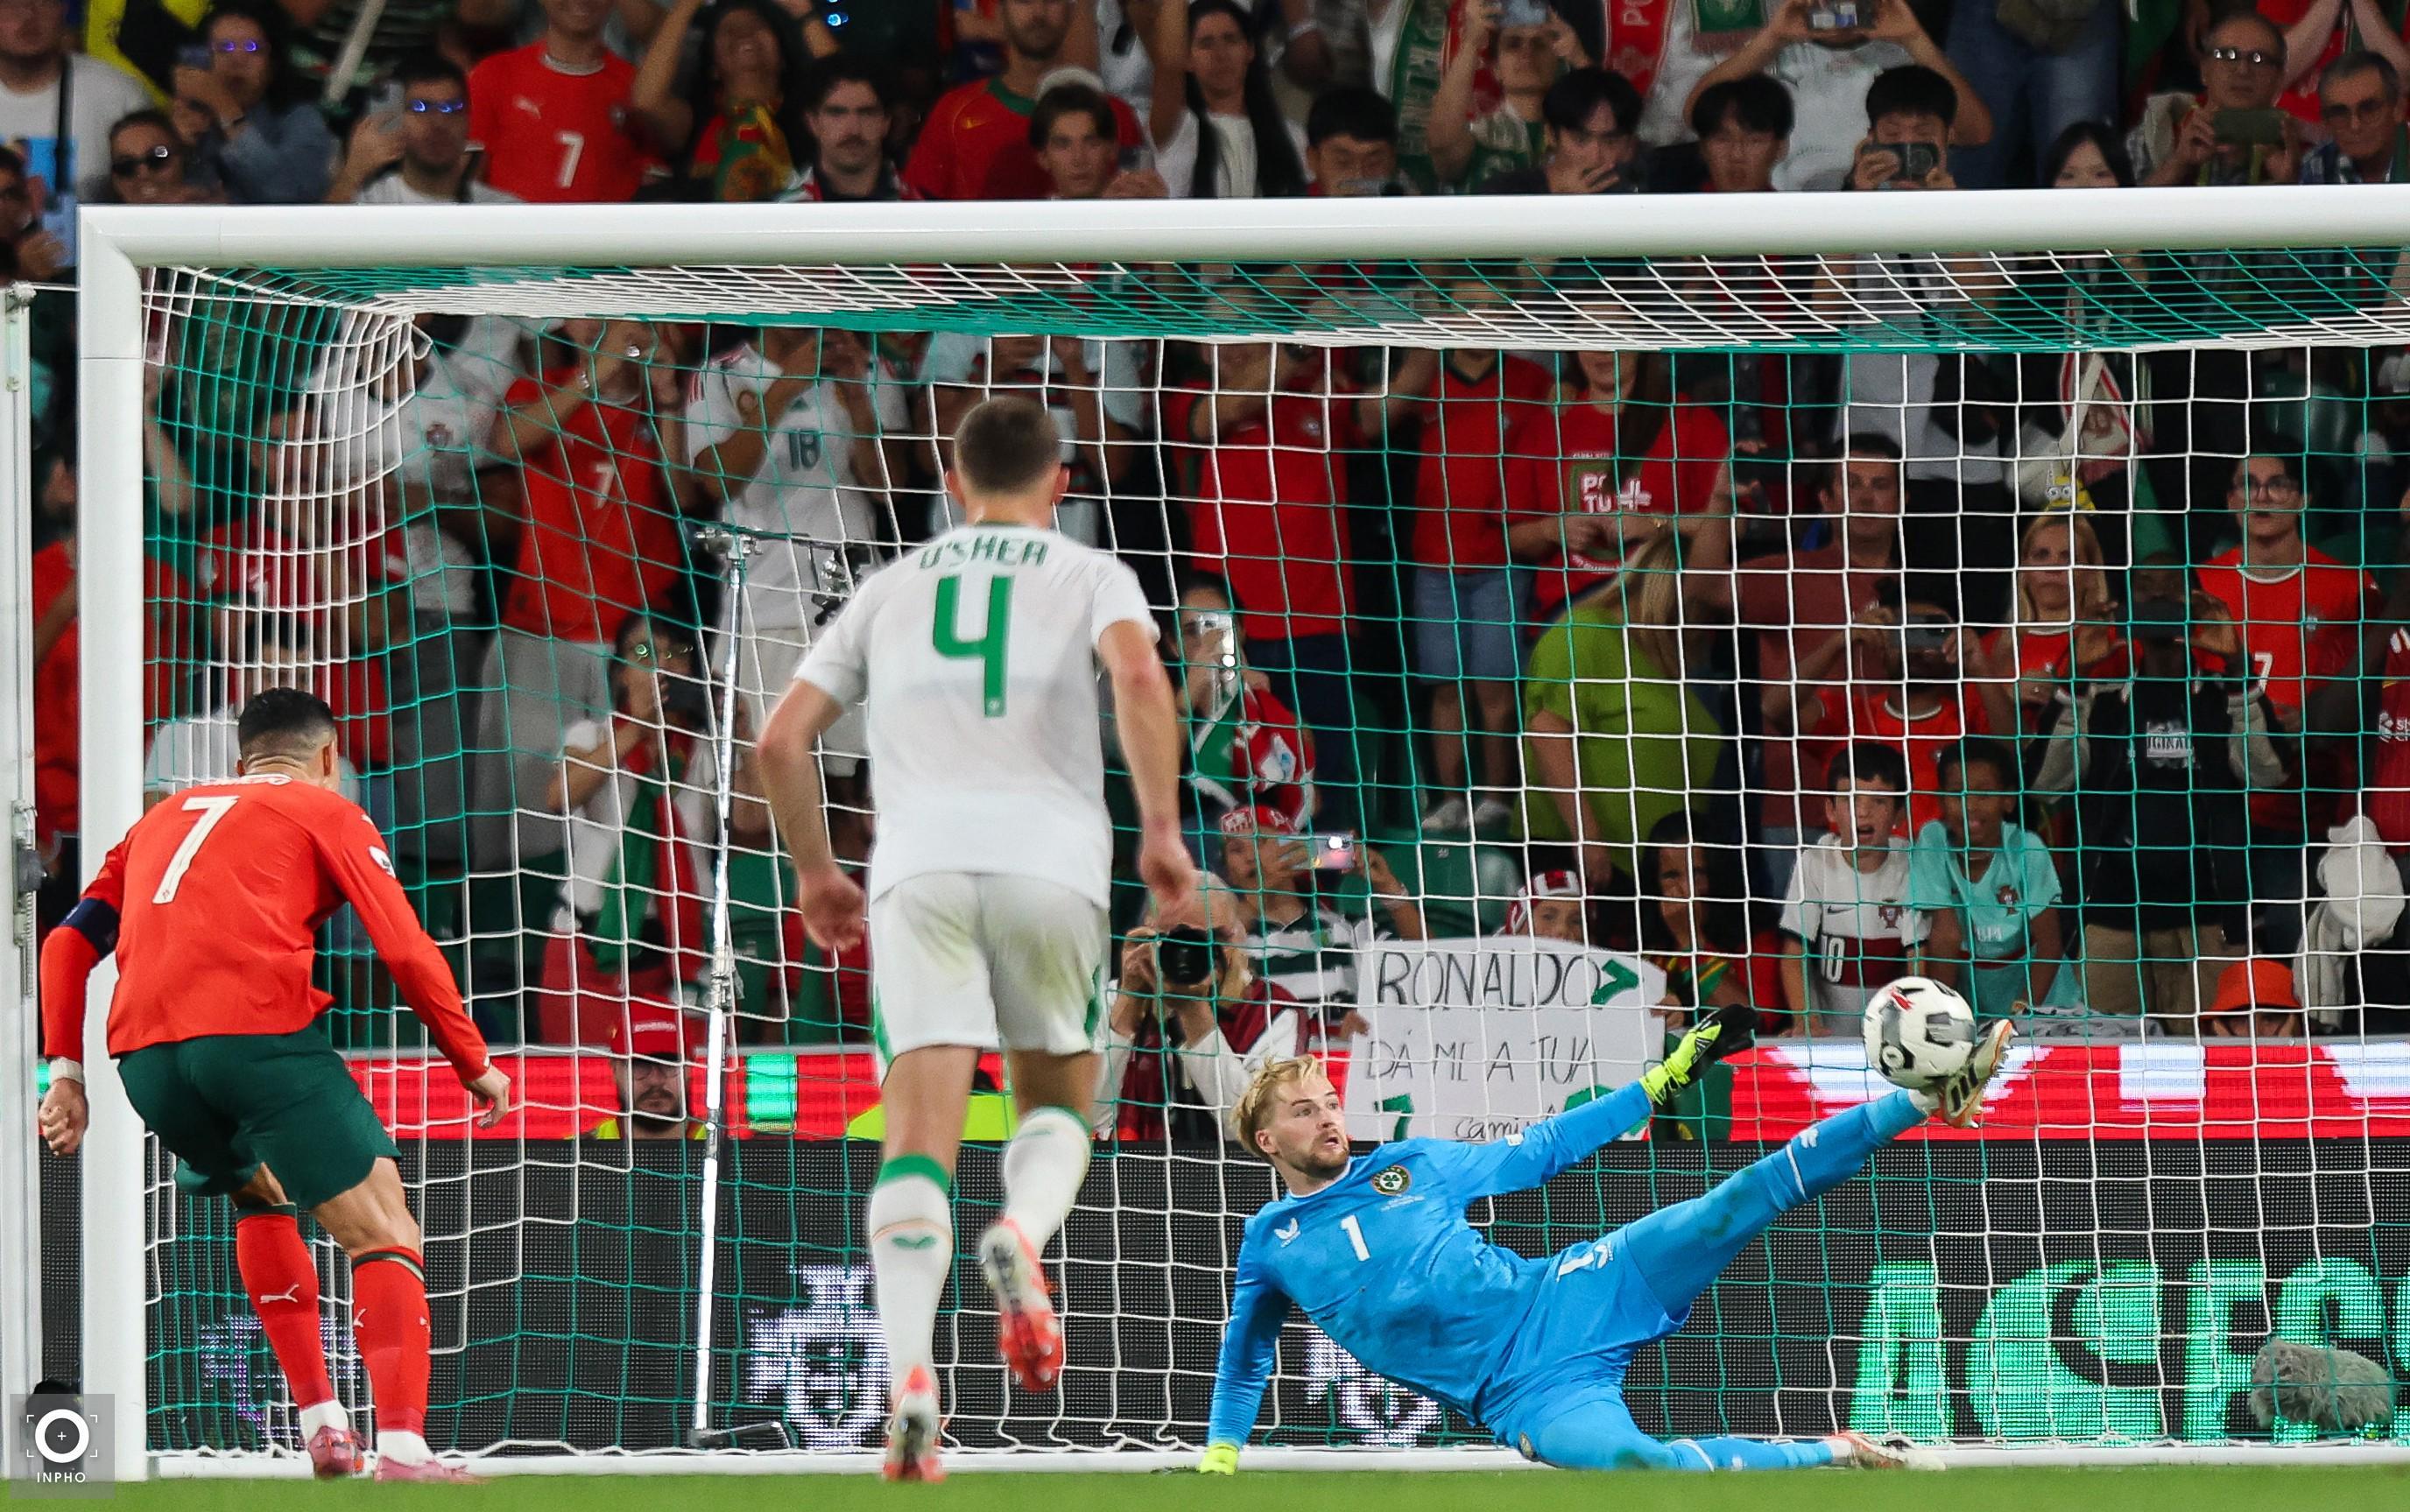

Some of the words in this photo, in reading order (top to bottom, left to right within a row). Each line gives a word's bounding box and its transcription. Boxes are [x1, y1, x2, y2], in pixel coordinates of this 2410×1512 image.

[558, 132, 584, 188] 7
[595, 462, 616, 510] 7
[933, 574, 1014, 718] 4
[2254, 651, 2273, 693] 7
[152, 796, 240, 904] 7
[1378, 950, 1601, 1010] RONALDO
[1822, 934, 1845, 982] 10
[1367, 1029, 1413, 1079] DÁ
[1434, 1041, 1475, 1081] ME
[1487, 1041, 1514, 1082] A
[1530, 1036, 1597, 1084] TUA
[1374, 1094, 1414, 1141] 7
[1340, 1214, 1371, 1262] 1
